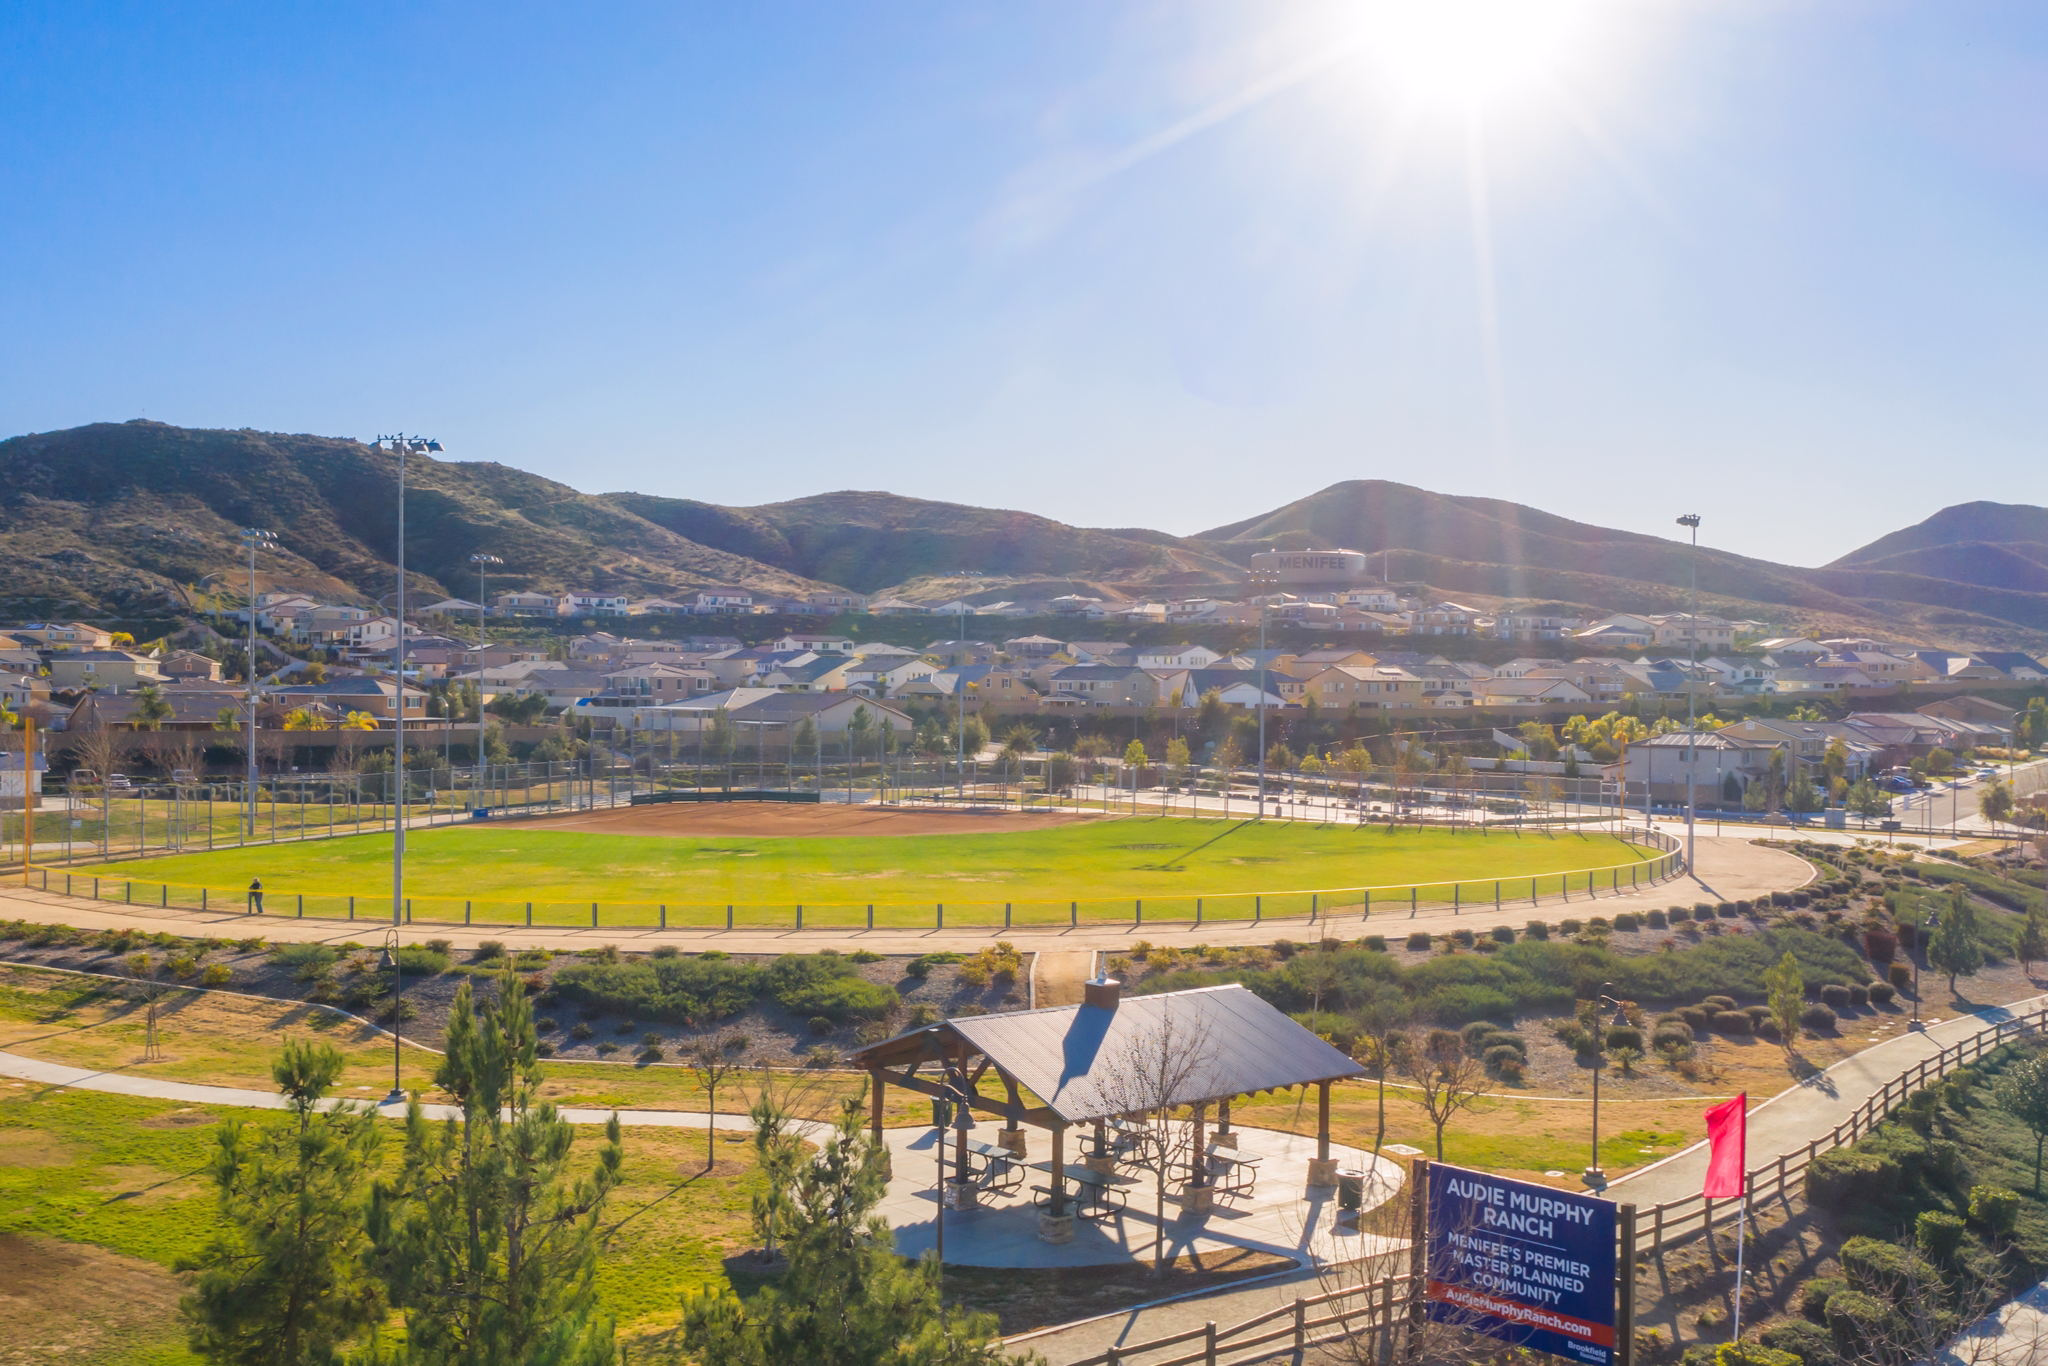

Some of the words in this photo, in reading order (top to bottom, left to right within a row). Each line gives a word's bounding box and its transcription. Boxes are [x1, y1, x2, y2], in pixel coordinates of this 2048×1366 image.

[1279, 556, 1346, 569] MENIFEE
[1447, 1178, 1504, 1206] AUDIE
[1510, 1191, 1594, 1225] MURPHY
[1484, 1207, 1553, 1239] RANCH
[1448, 1232, 1521, 1261] MENIFEE'S
[1525, 1251, 1590, 1278] PREMIER
[1453, 1250, 1509, 1275] MASTER
[1514, 1264, 1584, 1293] PLANNED
[1473, 1272, 1562, 1305] COMMUNITY
[1446, 1288, 1591, 1336] AudieMurphyRanch.com
[1568, 1341, 1606, 1358] Brookfield
